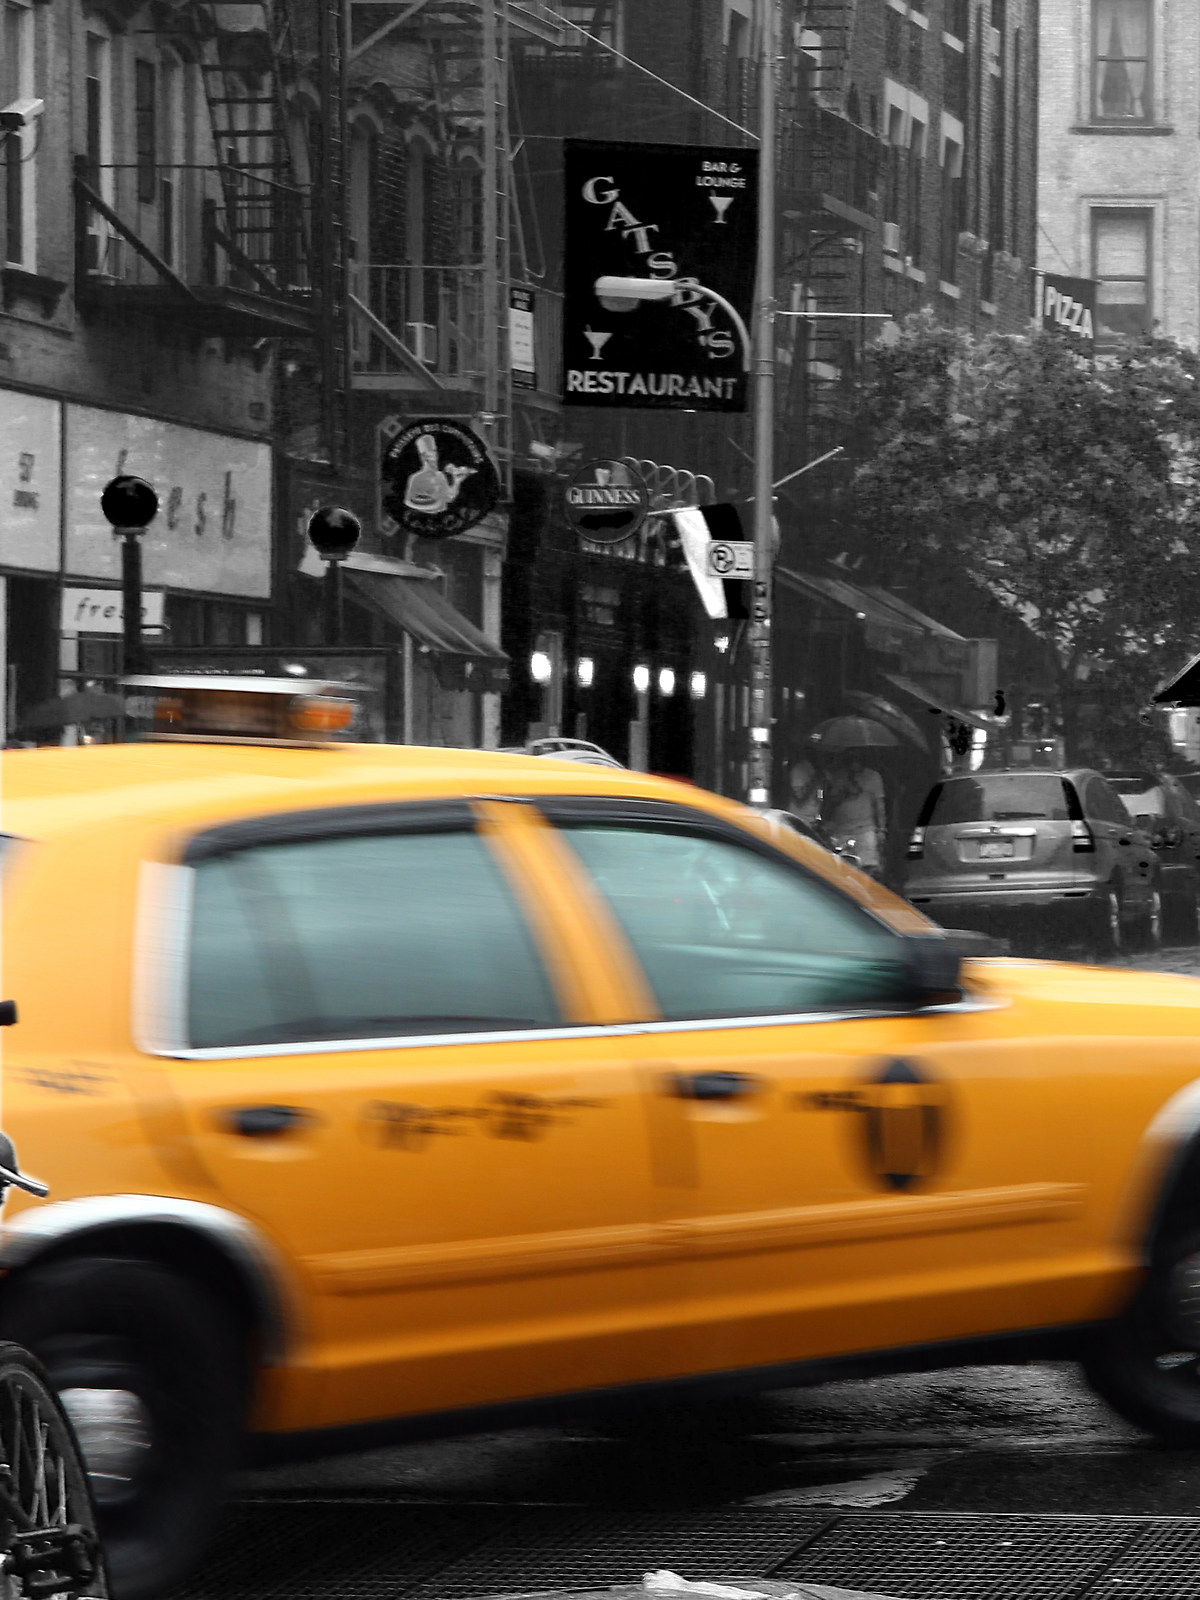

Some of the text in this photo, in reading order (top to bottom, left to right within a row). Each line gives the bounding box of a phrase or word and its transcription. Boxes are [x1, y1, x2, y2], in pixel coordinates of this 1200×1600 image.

[702, 161, 742, 173] BAR &
[695, 176, 746, 188] LOUNGE
[582, 176, 735, 359] GATSBY'S
[1044, 286, 1093, 339] PIZZA
[567, 369, 737, 399] RESTAURANT
[566, 487, 640, 504] GUINNESS
[74, 597, 148, 621] fre
